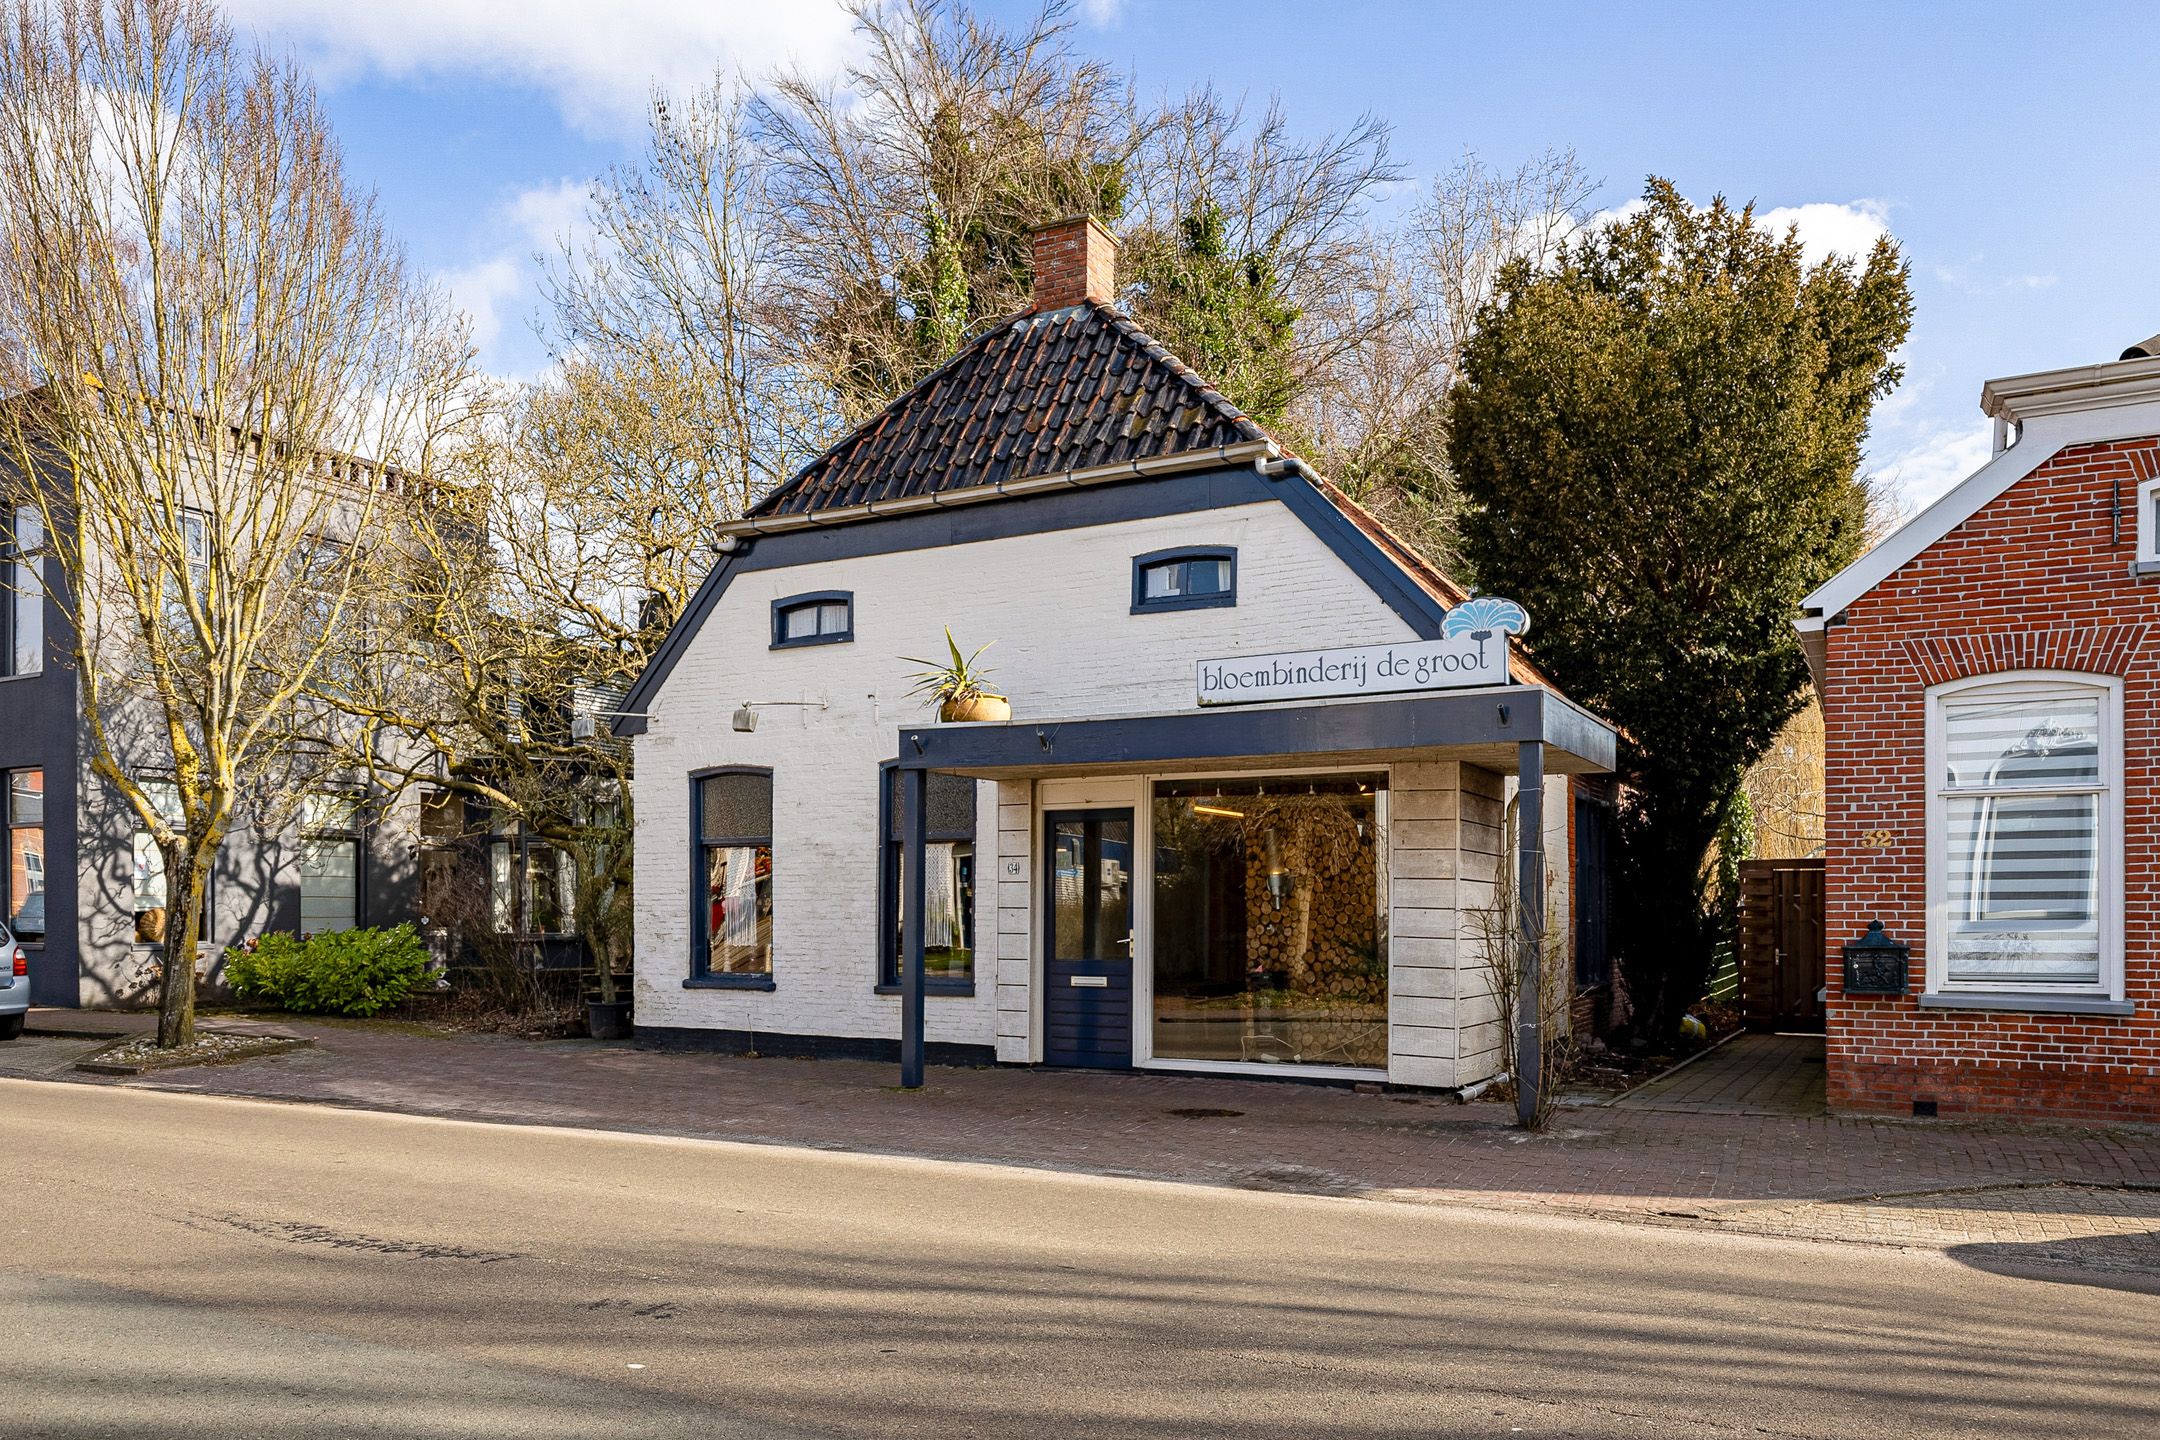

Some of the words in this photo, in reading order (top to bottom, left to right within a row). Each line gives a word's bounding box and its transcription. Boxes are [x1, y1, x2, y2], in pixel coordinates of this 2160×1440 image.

[1203, 656, 1366, 691] bloembinderij
[1377, 650, 1410, 677] de
[1415, 643, 1489, 684] groot
[1861, 830, 1892, 848] 32
[1007, 862, 1020, 875] 34
